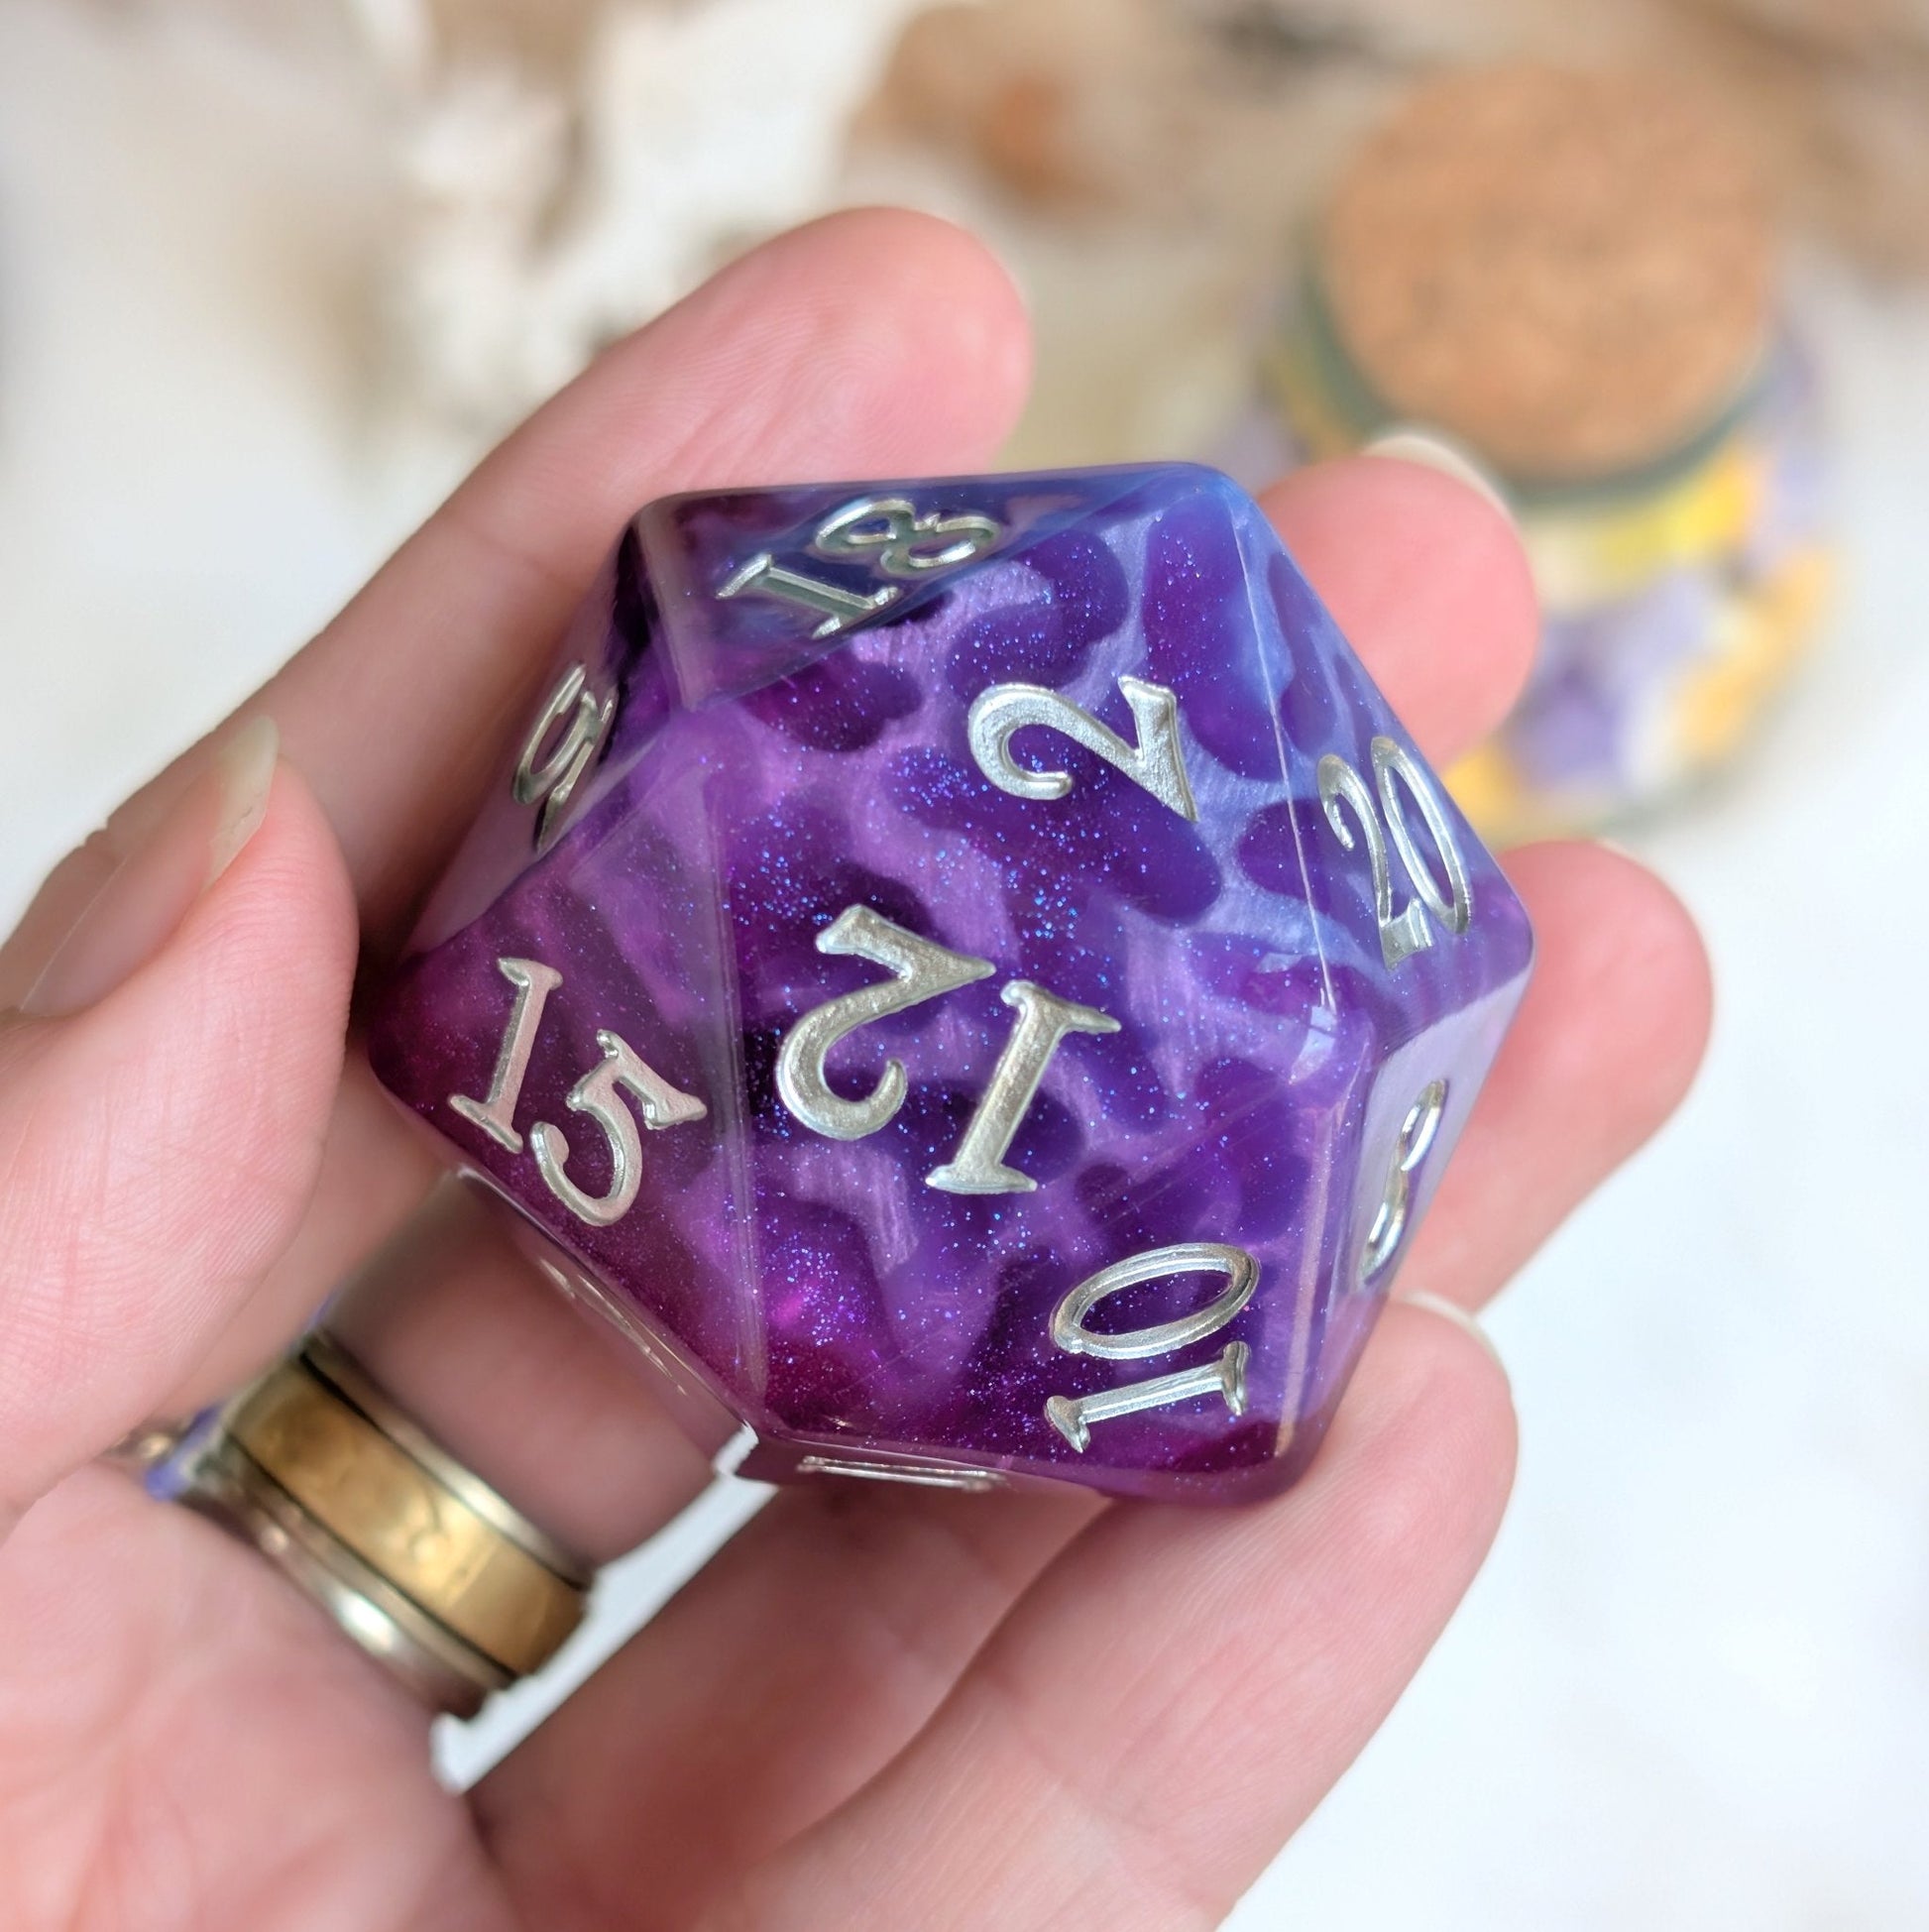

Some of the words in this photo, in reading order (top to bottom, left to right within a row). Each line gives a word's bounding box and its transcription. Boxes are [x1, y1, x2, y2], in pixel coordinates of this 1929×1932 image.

[716, 498, 1001, 639] 18
[968, 674, 1196, 823] 2
[1317, 737, 1472, 968] 20
[449, 958, 707, 1226] 15
[775, 903, 1122, 1194] 12
[1044, 1242, 1260, 1453] 10
